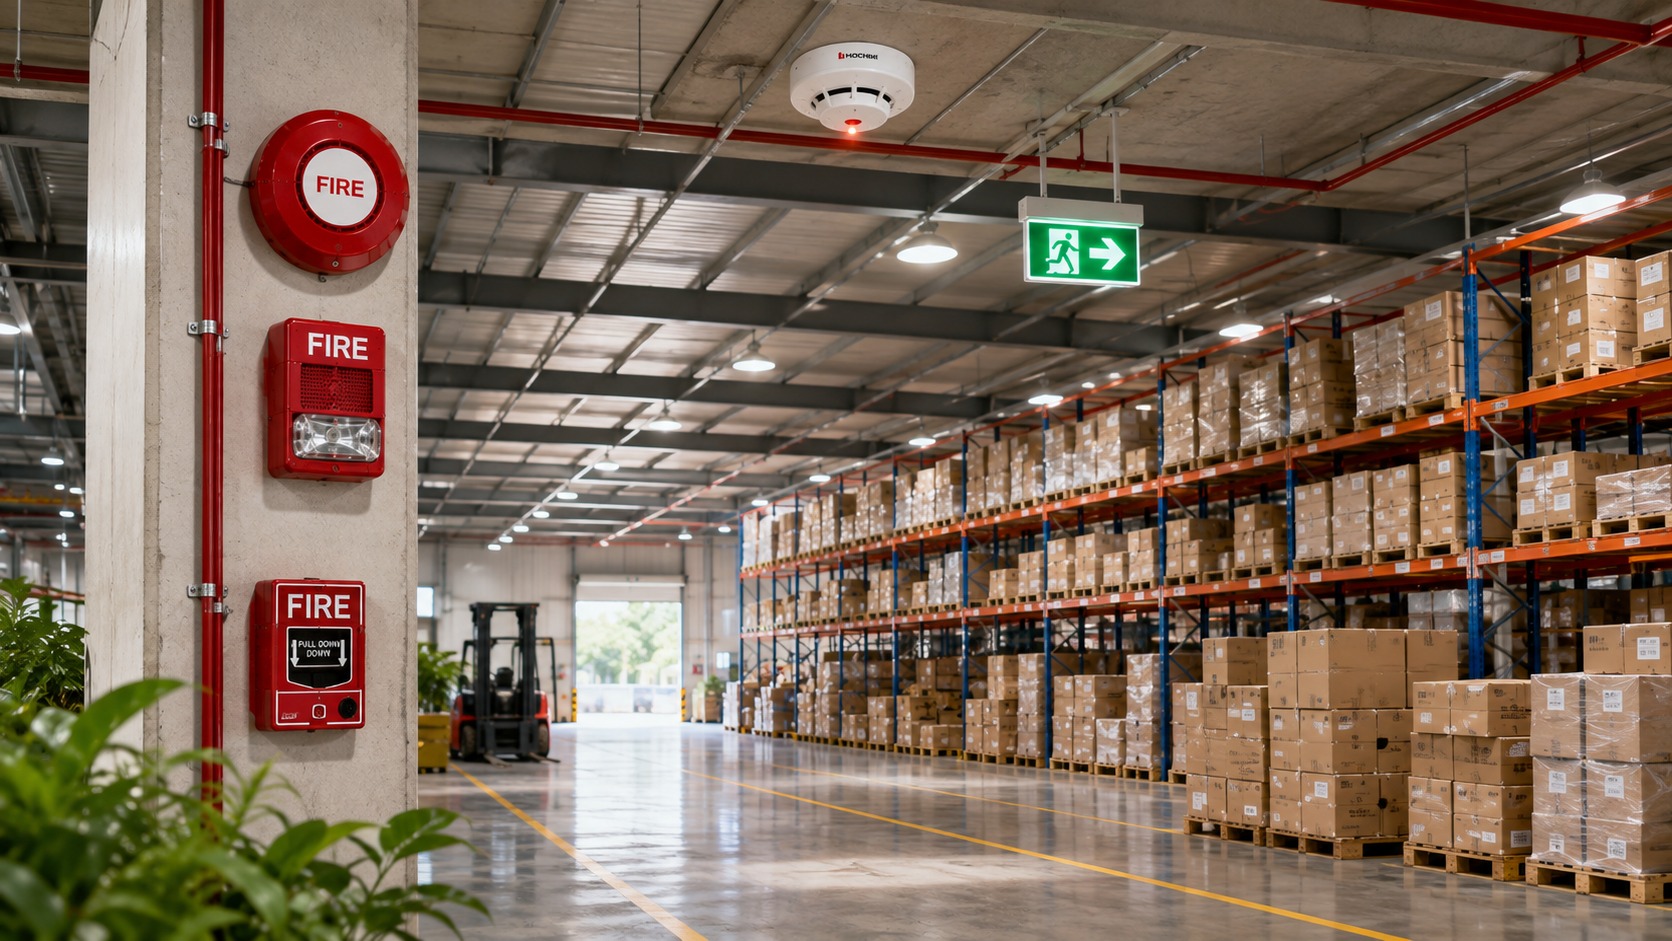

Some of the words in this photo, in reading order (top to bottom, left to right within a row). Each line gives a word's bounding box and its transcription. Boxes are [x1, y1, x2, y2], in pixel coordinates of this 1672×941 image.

[317, 175, 364, 198] FIRE
[308, 332, 368, 360] FIRE
[288, 594, 351, 619] FIRE
[298, 640, 316, 648] PULL
